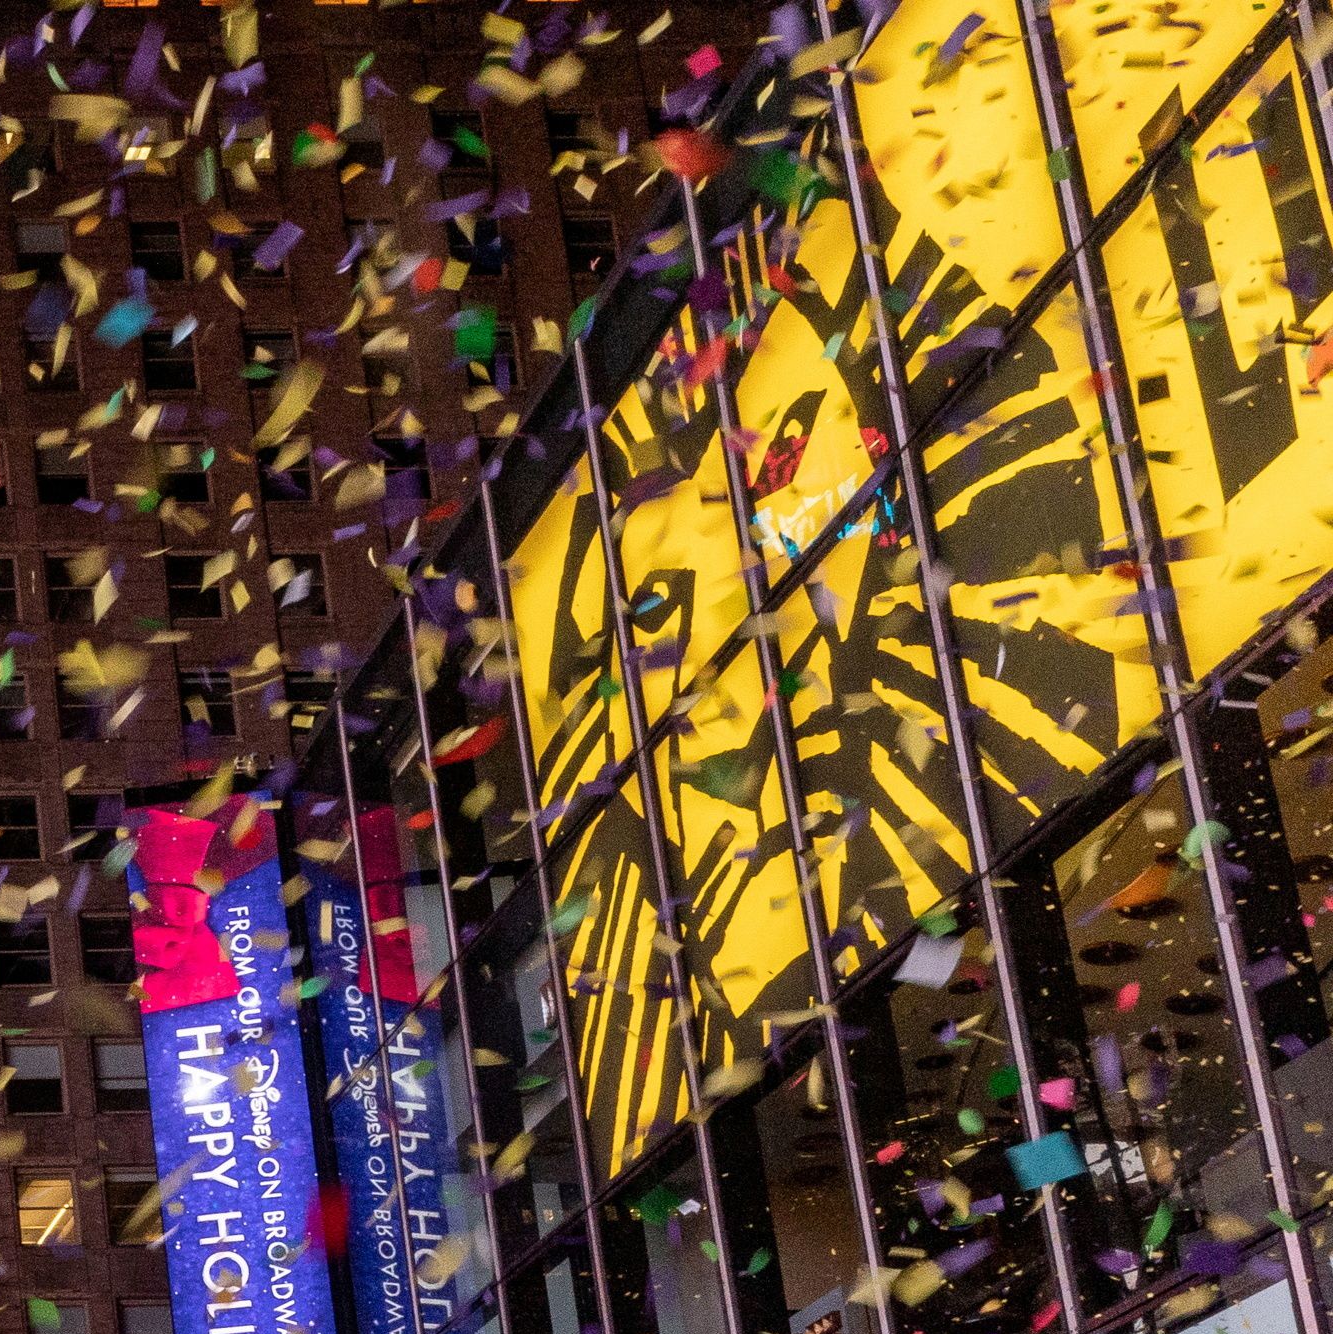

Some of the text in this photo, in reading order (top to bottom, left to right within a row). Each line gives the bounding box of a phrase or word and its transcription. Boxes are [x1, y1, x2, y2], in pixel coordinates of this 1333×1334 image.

[227, 904, 258, 978] FROM
[235, 986, 263, 1043] OUR
[175, 1023, 240, 1190] HAPPY
[256, 1157, 284, 1200] ON
